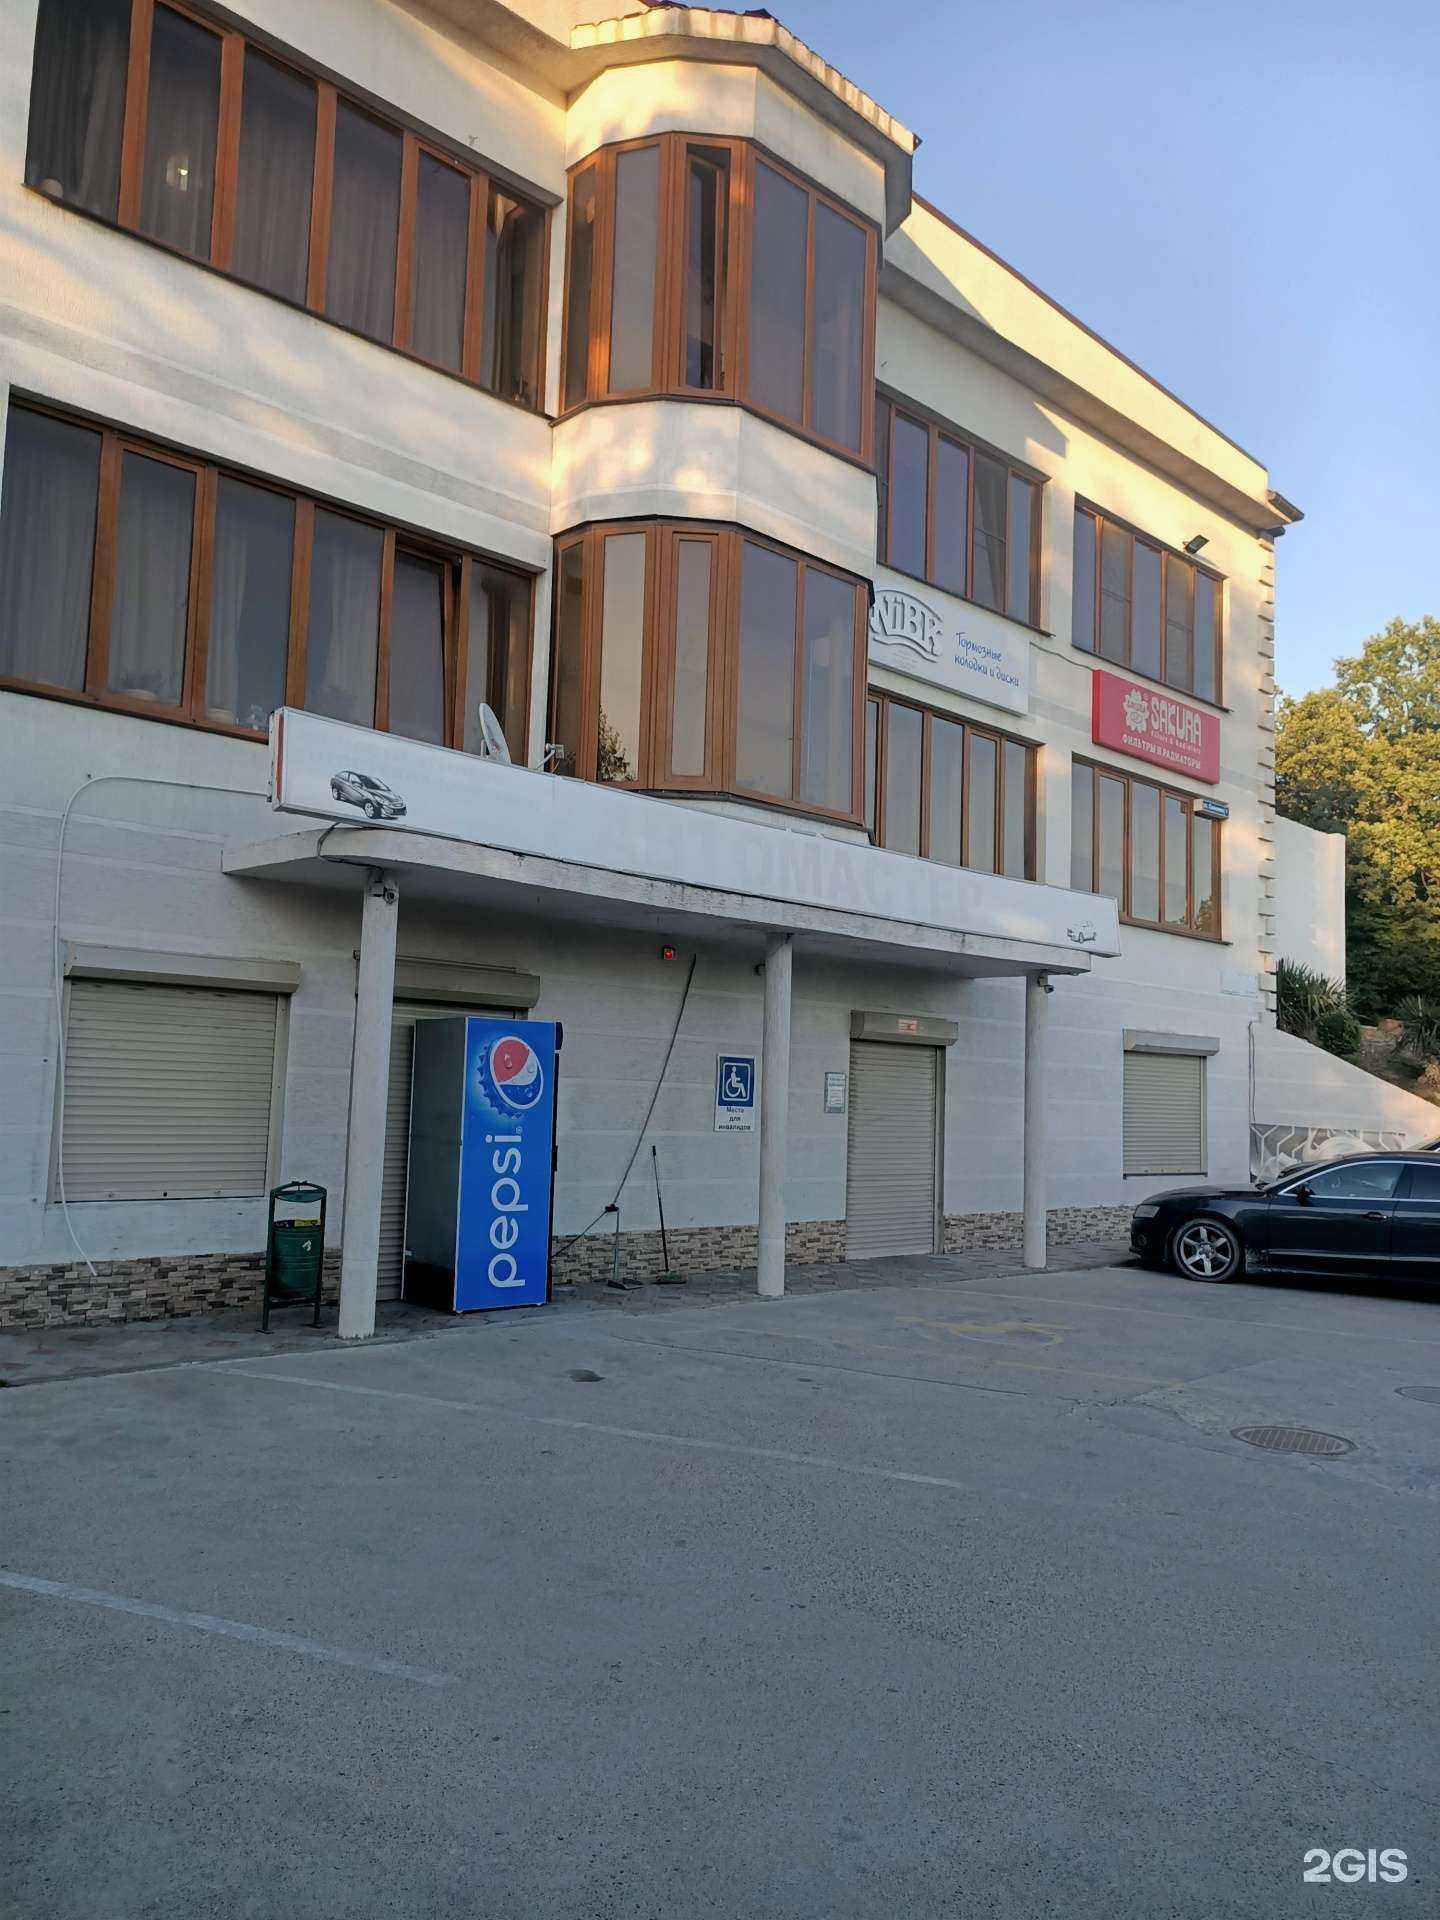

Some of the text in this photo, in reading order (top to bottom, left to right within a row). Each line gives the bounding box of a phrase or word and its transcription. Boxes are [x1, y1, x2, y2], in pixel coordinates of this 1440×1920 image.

[955, 632, 1003, 662] Тормозные
[954, 655, 988, 676] колодки
[996, 666, 1019, 687] диски
[1151, 697, 1202, 747] SAKURA
[485, 1133, 529, 1288] pepsi
